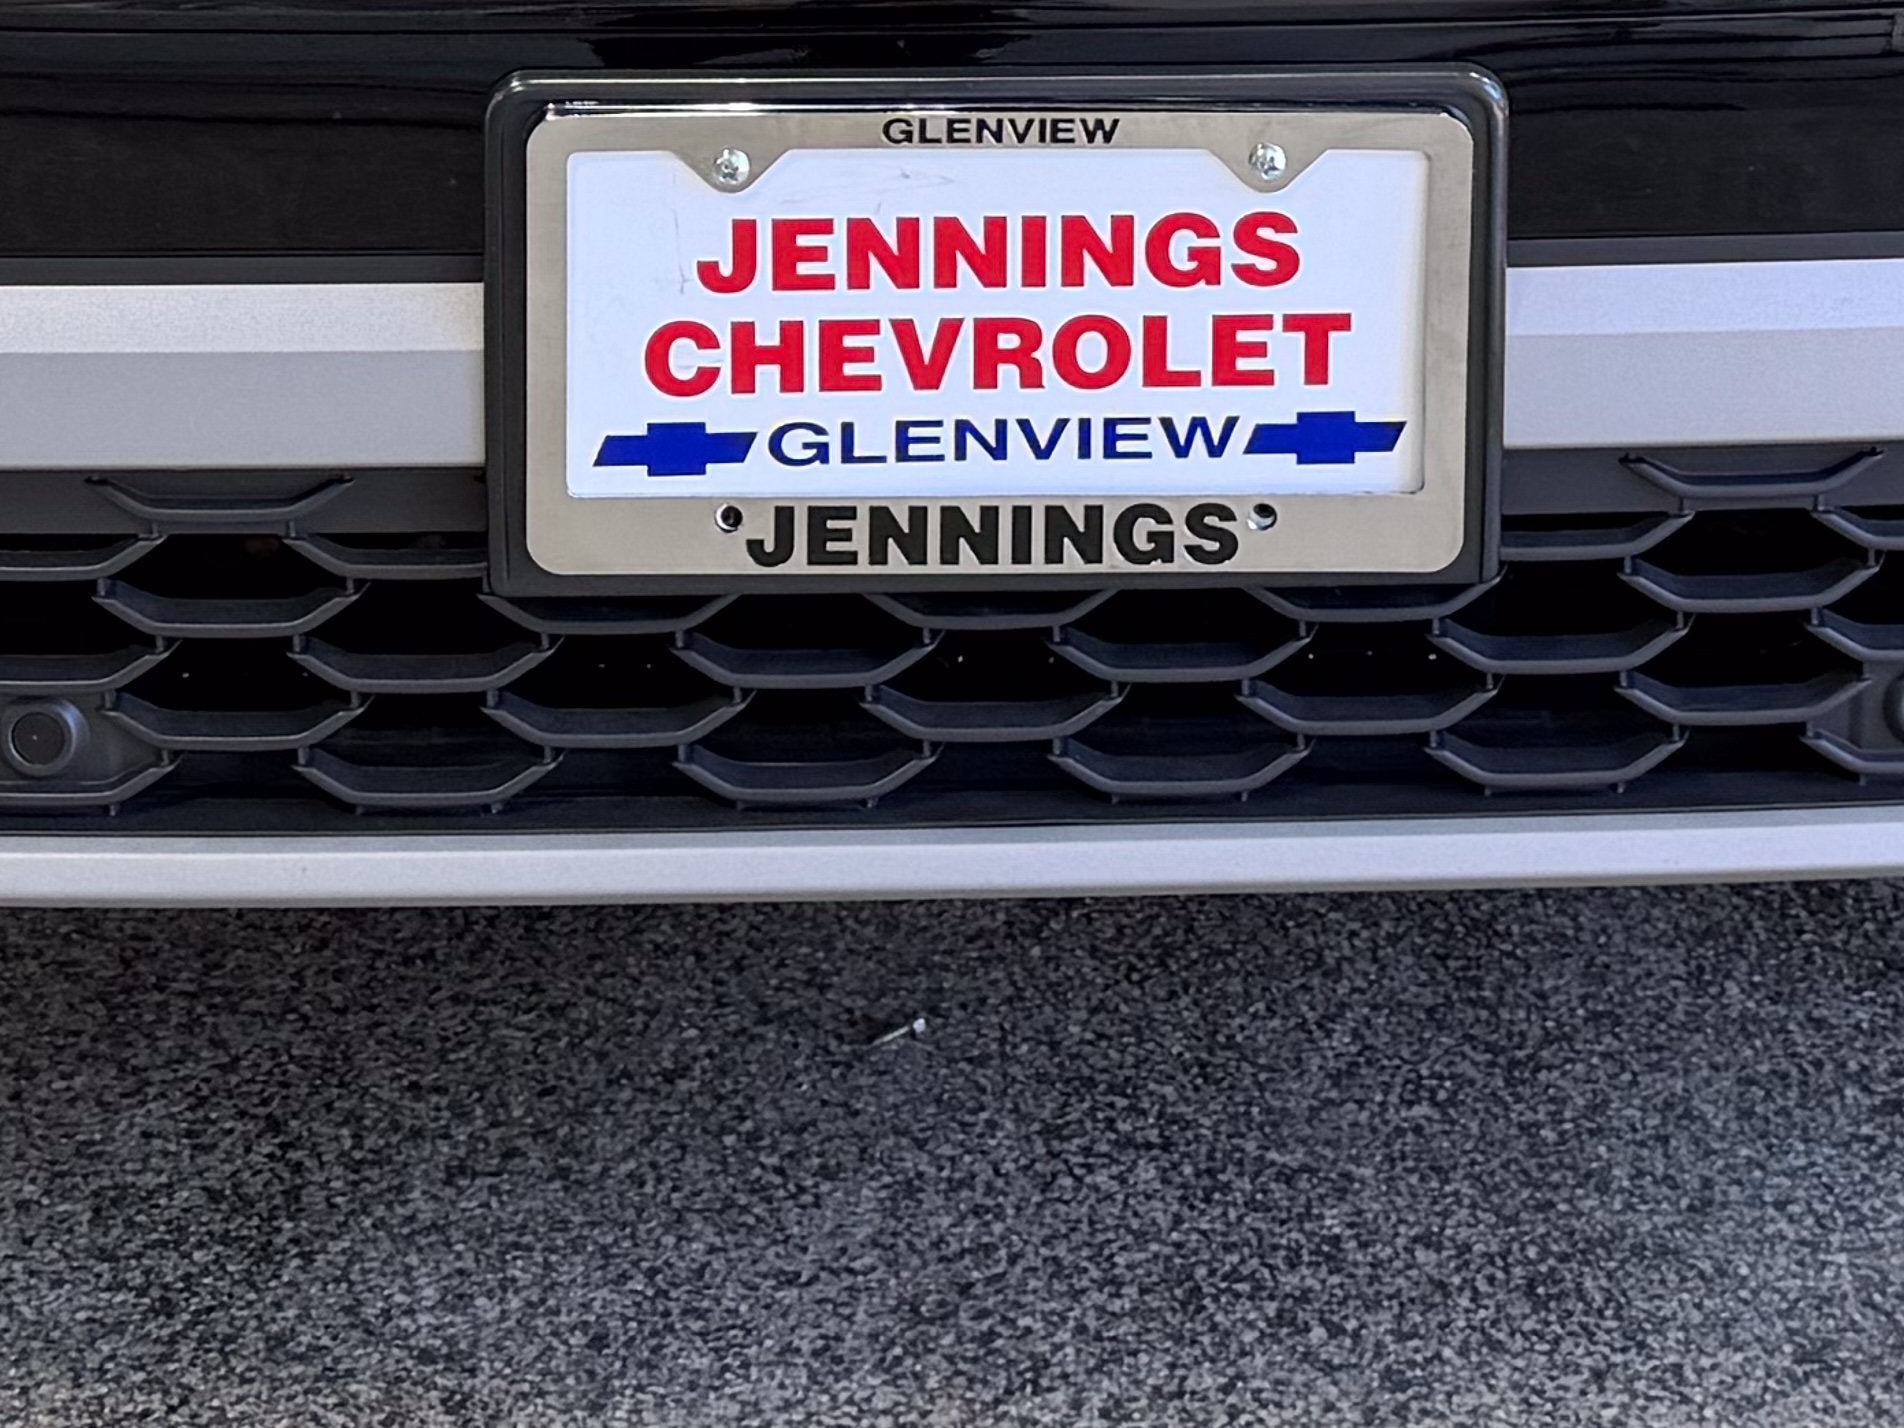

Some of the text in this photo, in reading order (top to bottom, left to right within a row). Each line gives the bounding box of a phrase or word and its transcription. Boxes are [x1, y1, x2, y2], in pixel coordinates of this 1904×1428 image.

[882, 117, 1121, 145] GLENVIEW
[697, 211, 1301, 295] JENNINGS
[644, 313, 1353, 398] CHEVROLET
[768, 415, 1240, 467] GLENVIEW
[745, 502, 1239, 568] JENNINGS
